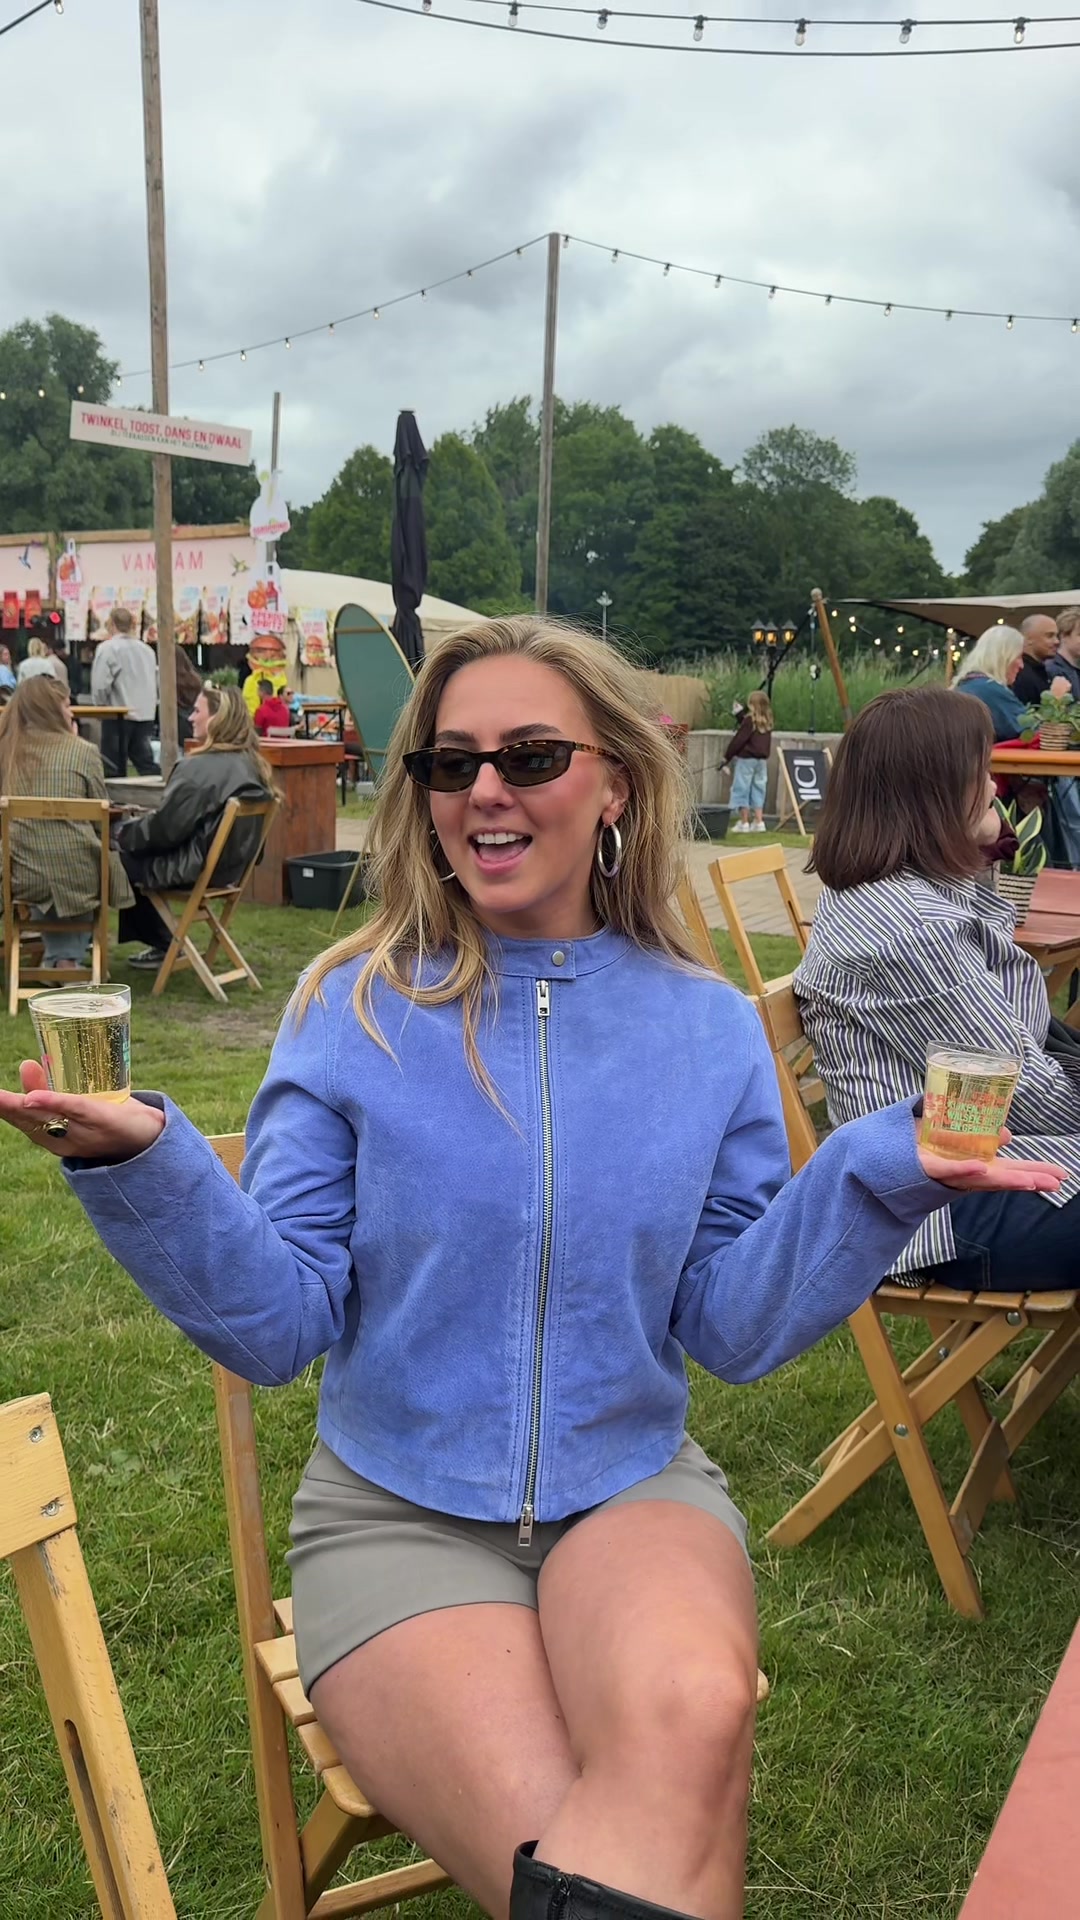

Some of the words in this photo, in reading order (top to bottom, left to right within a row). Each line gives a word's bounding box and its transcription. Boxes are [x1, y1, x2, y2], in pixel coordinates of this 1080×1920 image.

[81, 412, 127, 431] TWINKEL,
[130, 420, 162, 437] TOOST,
[165, 426, 191, 440] DANS
[194, 433, 206, 443] EN
[209, 434, 242, 449] DWAAL
